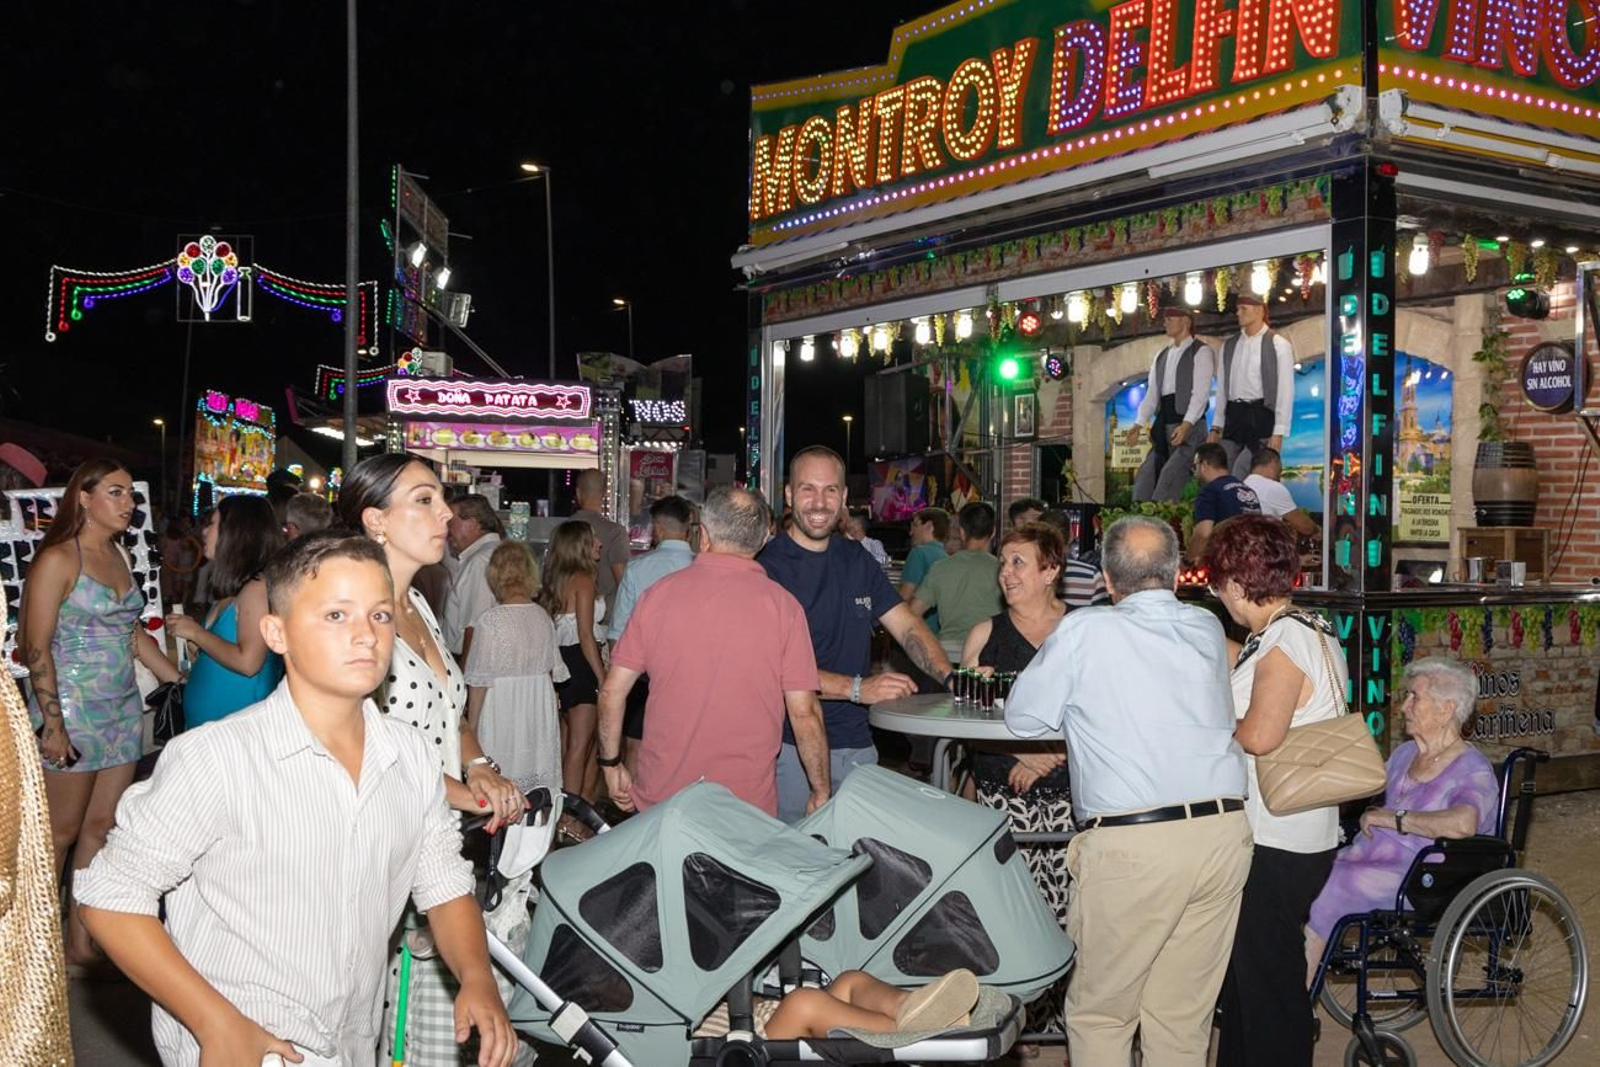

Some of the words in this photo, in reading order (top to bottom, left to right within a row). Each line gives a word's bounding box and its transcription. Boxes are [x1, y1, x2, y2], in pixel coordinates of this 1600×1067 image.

[750, 37, 1038, 221] MONTROY
[1532, 361, 1547, 374] HAY
[1548, 359, 1566, 372] VINO
[1526, 378, 1538, 390] SIN
[1539, 375, 1572, 390] ALCOHOL
[437, 389, 471, 404] DOÑA
[485, 393, 538, 407] PATATA
[1369, 293, 1389, 515] DELFIN
[1412, 495, 1440, 505] OFERTA
[1366, 615, 1386, 737] VINO
